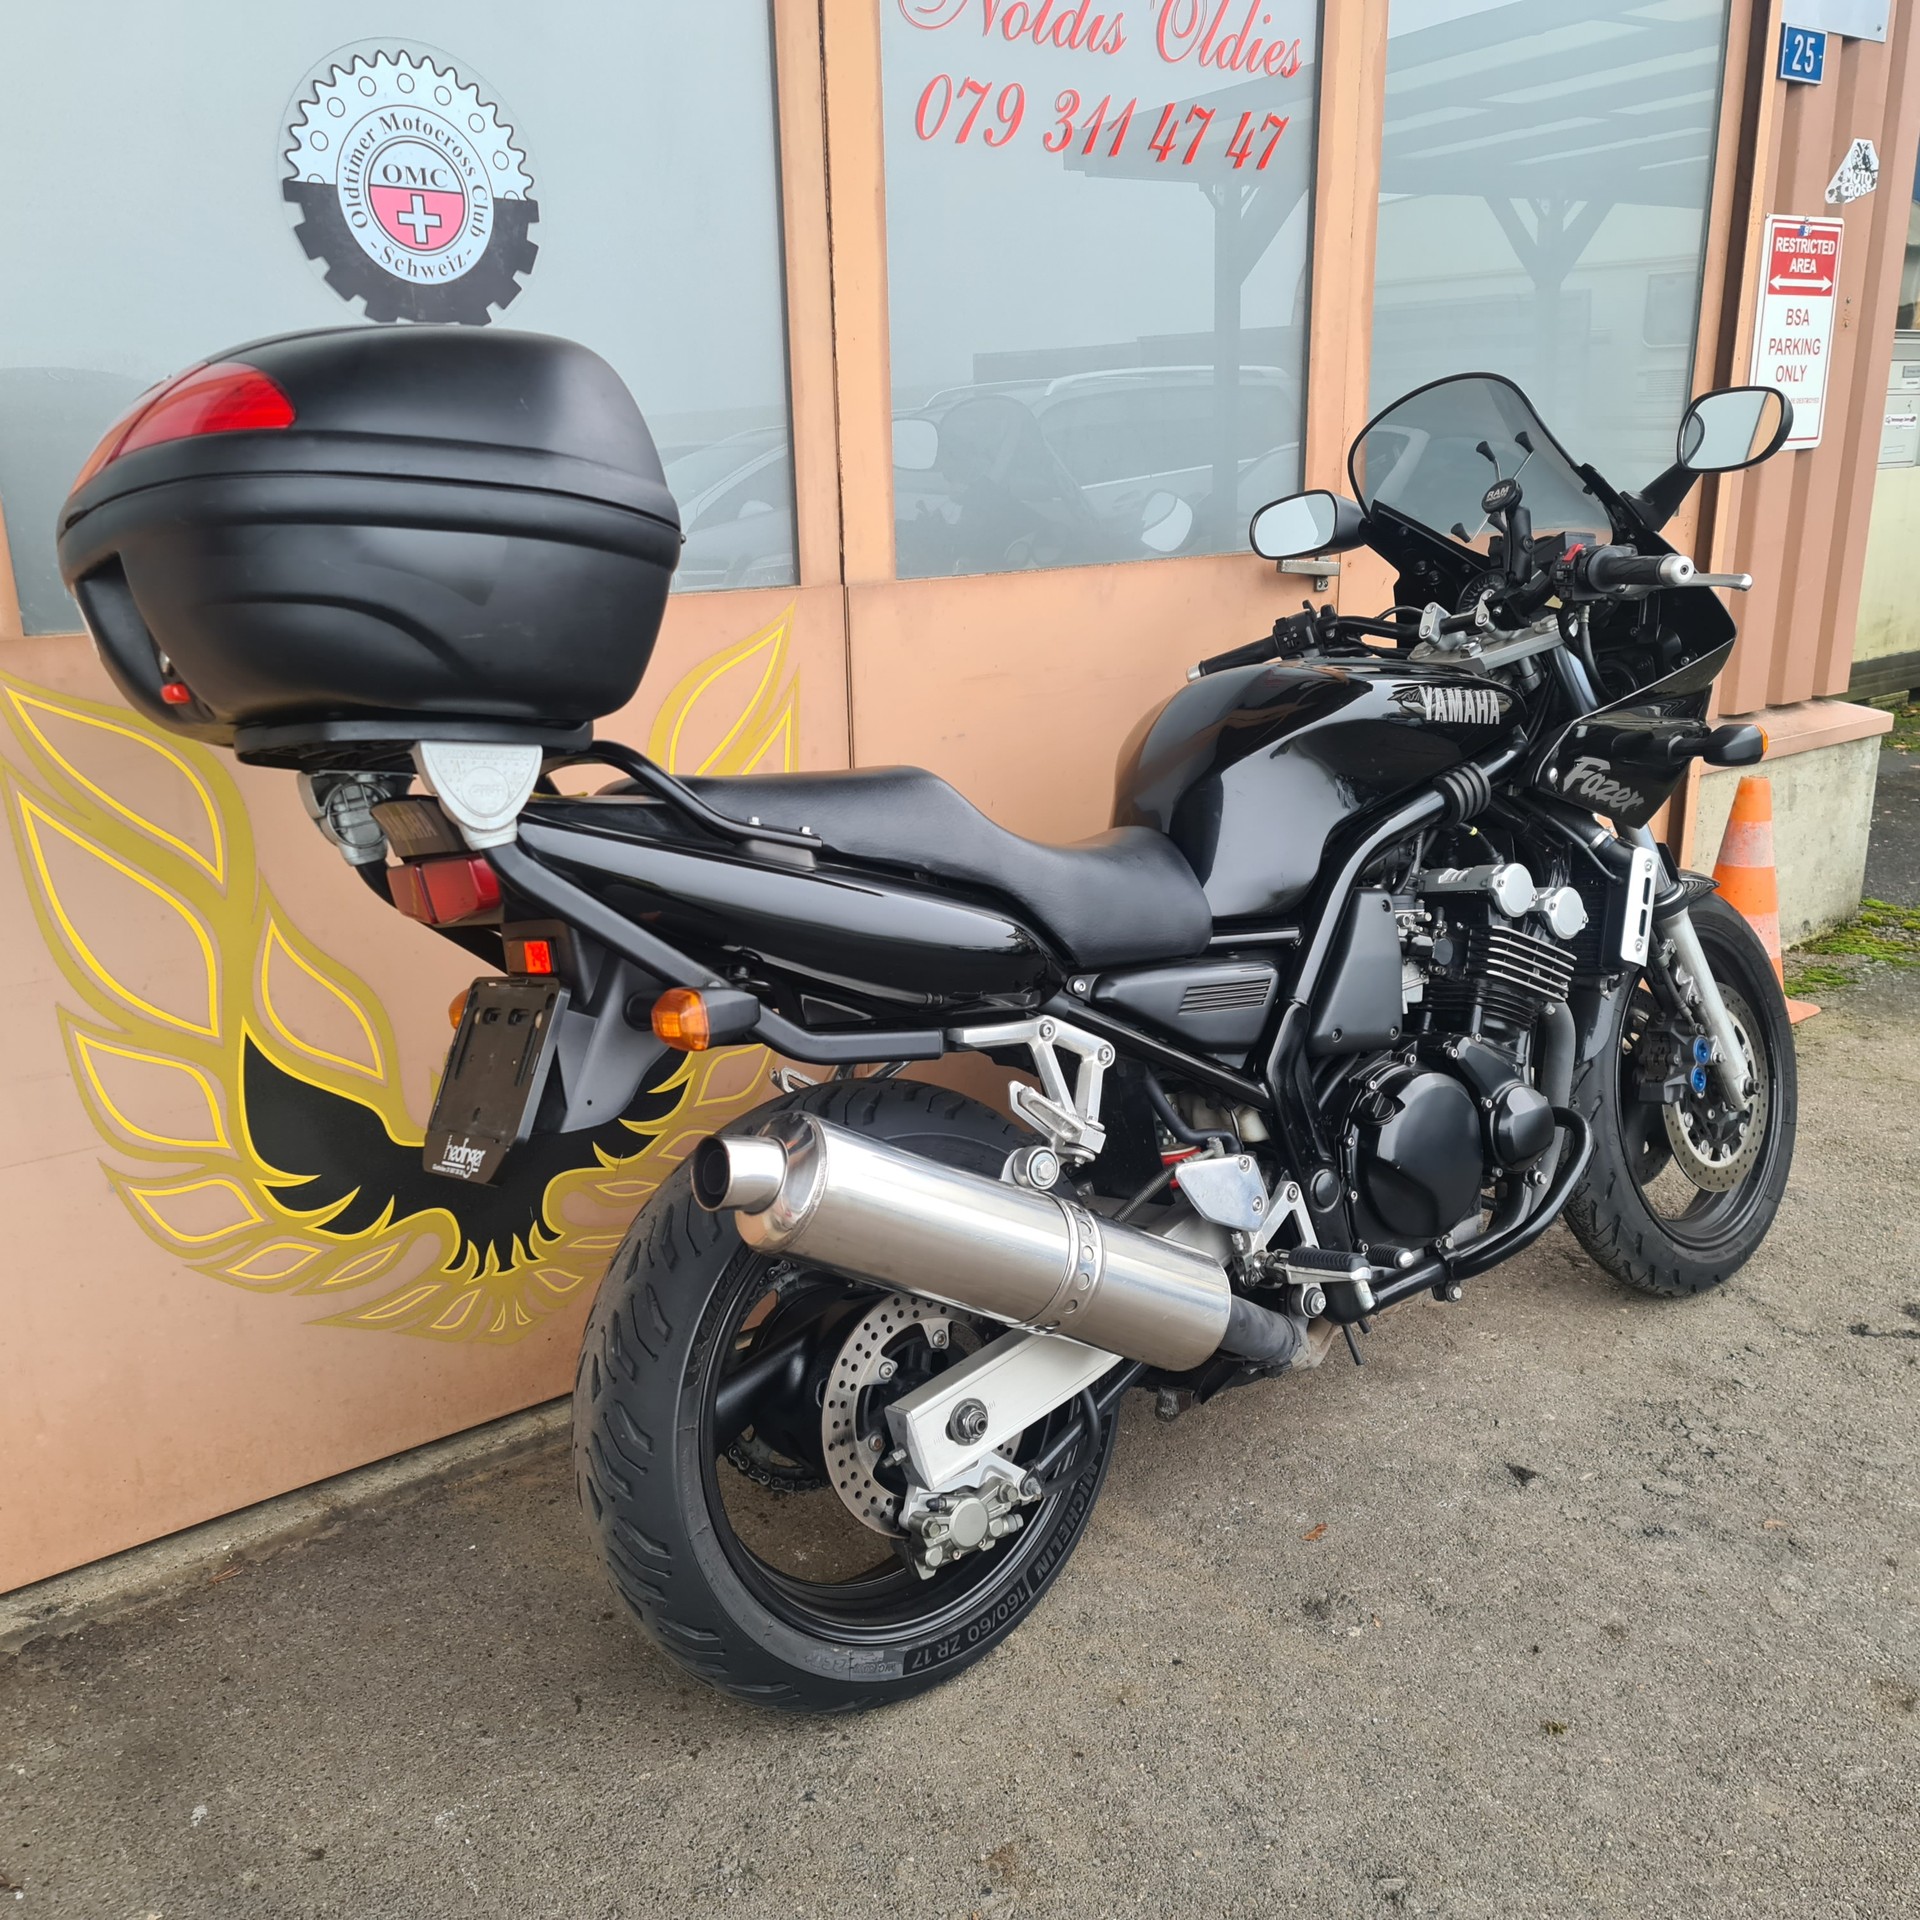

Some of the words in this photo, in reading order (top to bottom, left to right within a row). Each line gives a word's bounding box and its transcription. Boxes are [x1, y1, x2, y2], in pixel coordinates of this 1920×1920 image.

[1151, 0, 1302, 78] Oldies
[1791, 34, 1815, 73] 25
[915, 74, 1025, 147] 079
[1043, 89, 1138, 157] 311
[1148, 102, 1215, 165] 47
[1225, 111, 1289, 170] 47
[344, 128, 377, 229] Oldtimer
[379, 112, 477, 178] Motocross
[469, 184, 488, 238] Club
[382, 163, 448, 188] OMC
[1775, 236, 1836, 255] RESTRICTED
[1788, 257, 1817, 274] AREA
[1785, 308, 1810, 326] BSA
[1768, 338, 1821, 356] PARKING
[1775, 365, 1807, 382] ONLY
[1487, 486, 1510, 498] RAM
[1418, 684, 1500, 725] YAMAHA
[1562, 755, 1645, 813] Fazer
[1033, 1462, 1098, 1580] MICHELIN
[967, 1584, 1027, 1642] 160/60
[911, 1649, 933, 1669] 17
[938, 1640, 961, 1660] ZR
